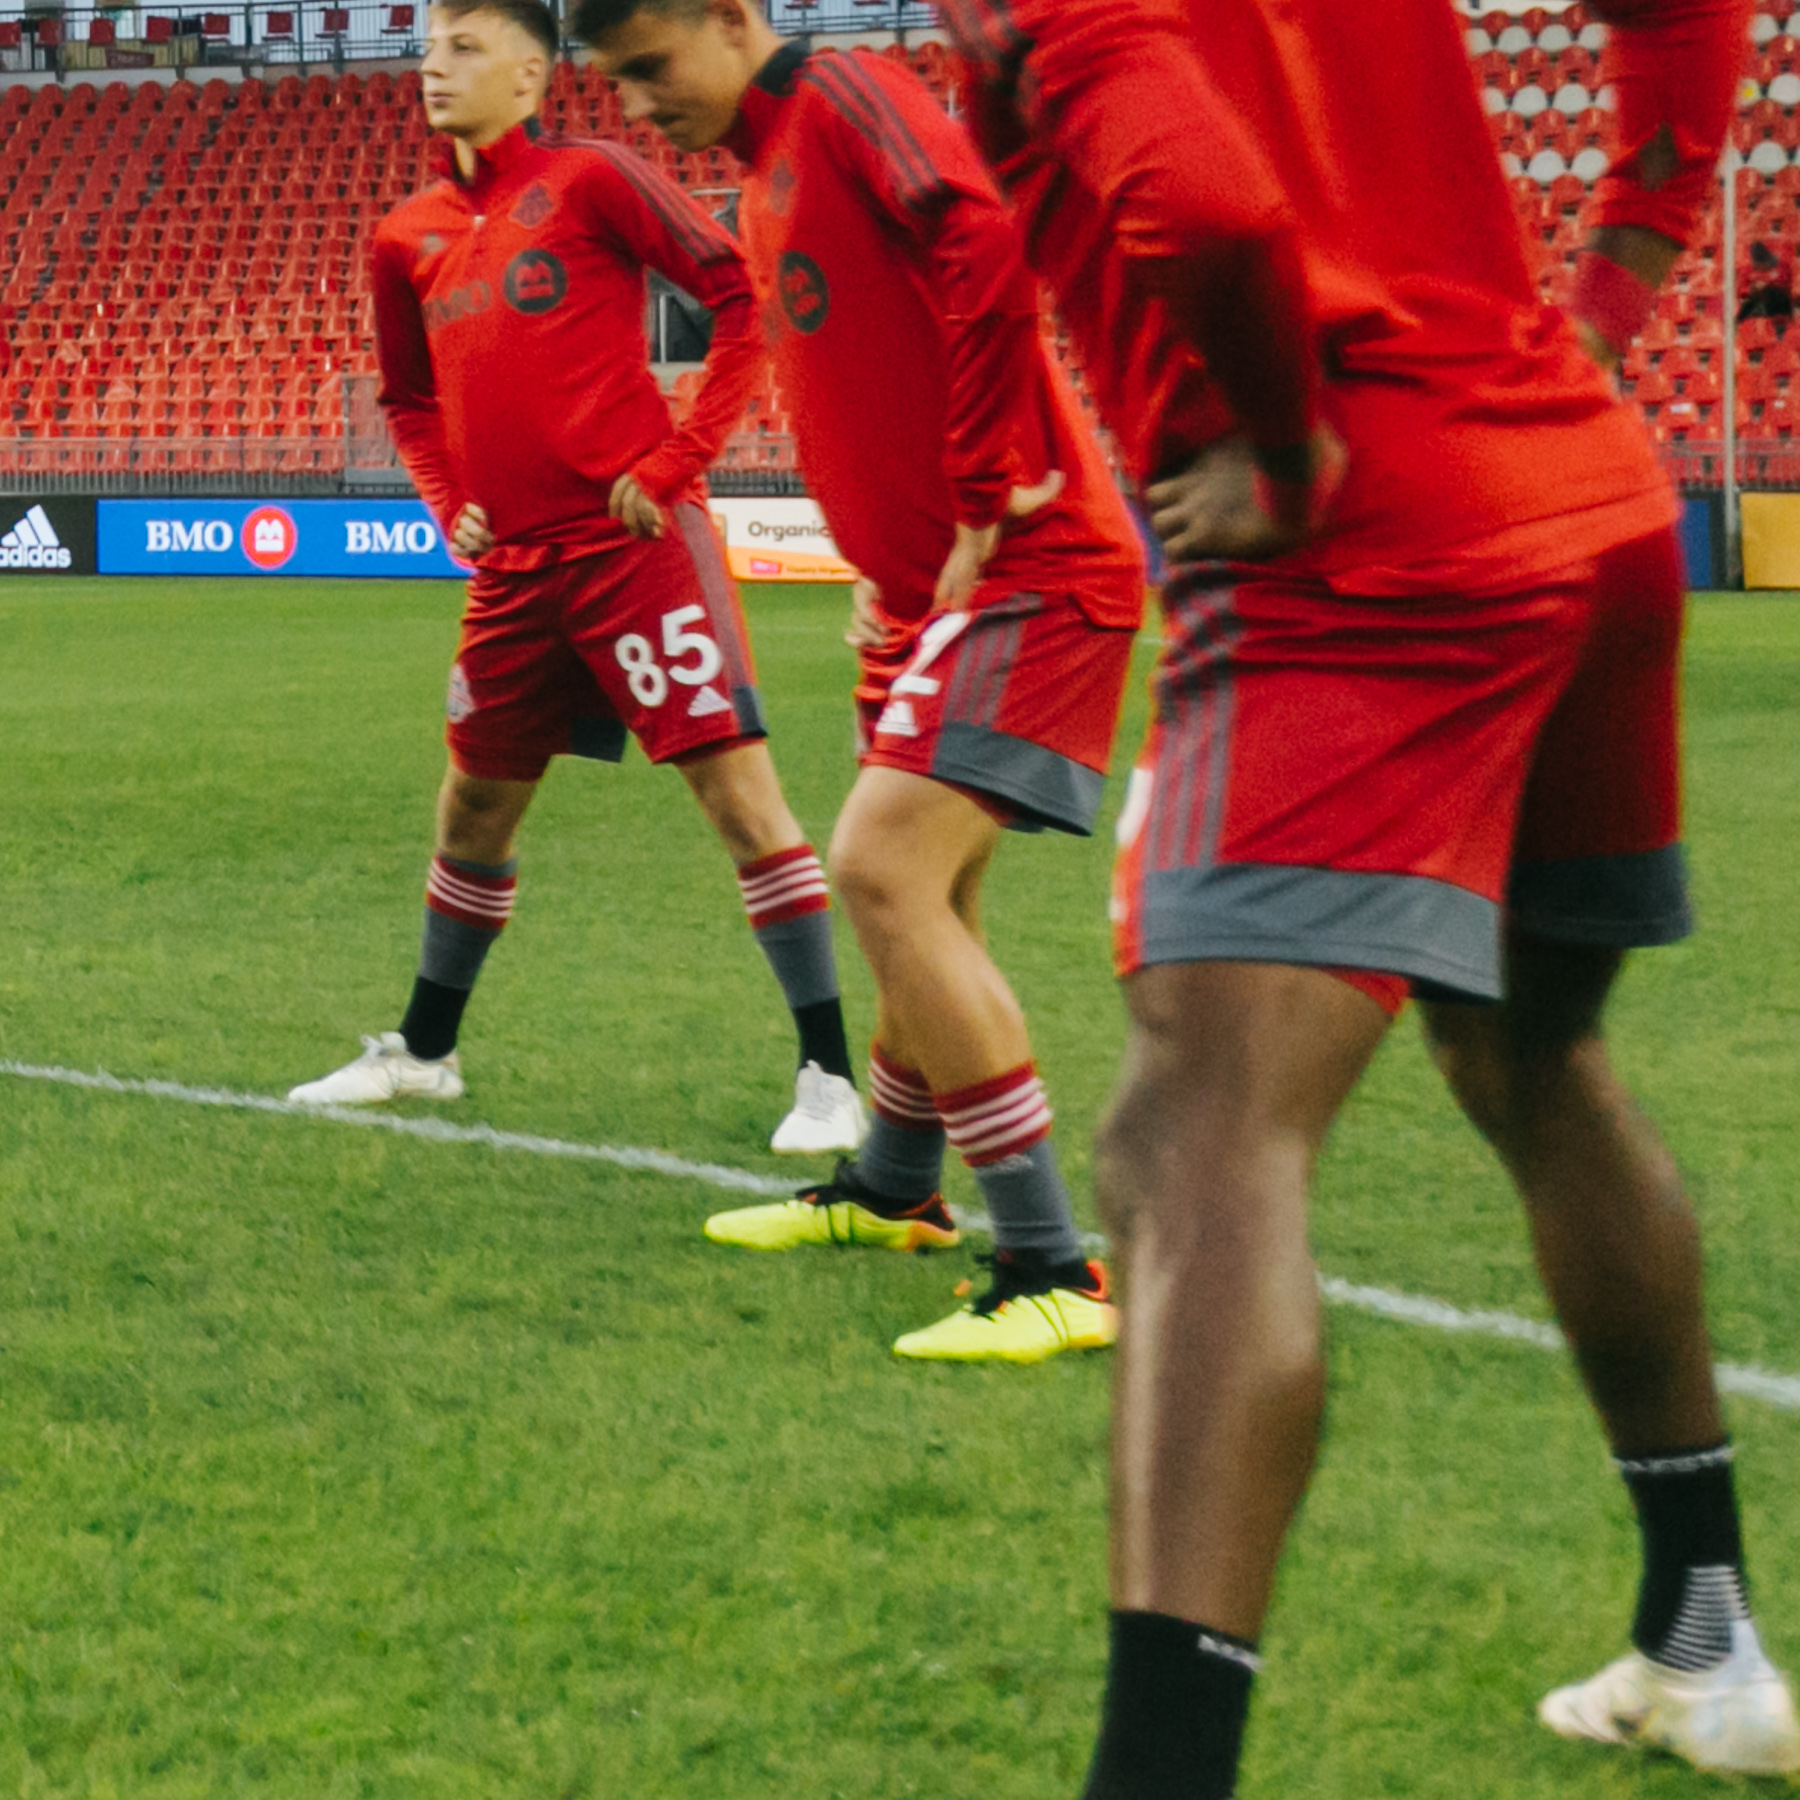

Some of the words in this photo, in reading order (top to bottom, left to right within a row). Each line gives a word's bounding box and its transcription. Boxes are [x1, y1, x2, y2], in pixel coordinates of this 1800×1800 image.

[145, 520, 233, 552] BMO
[344, 521, 437, 554] BMO
[614, 604, 723, 708] 85
